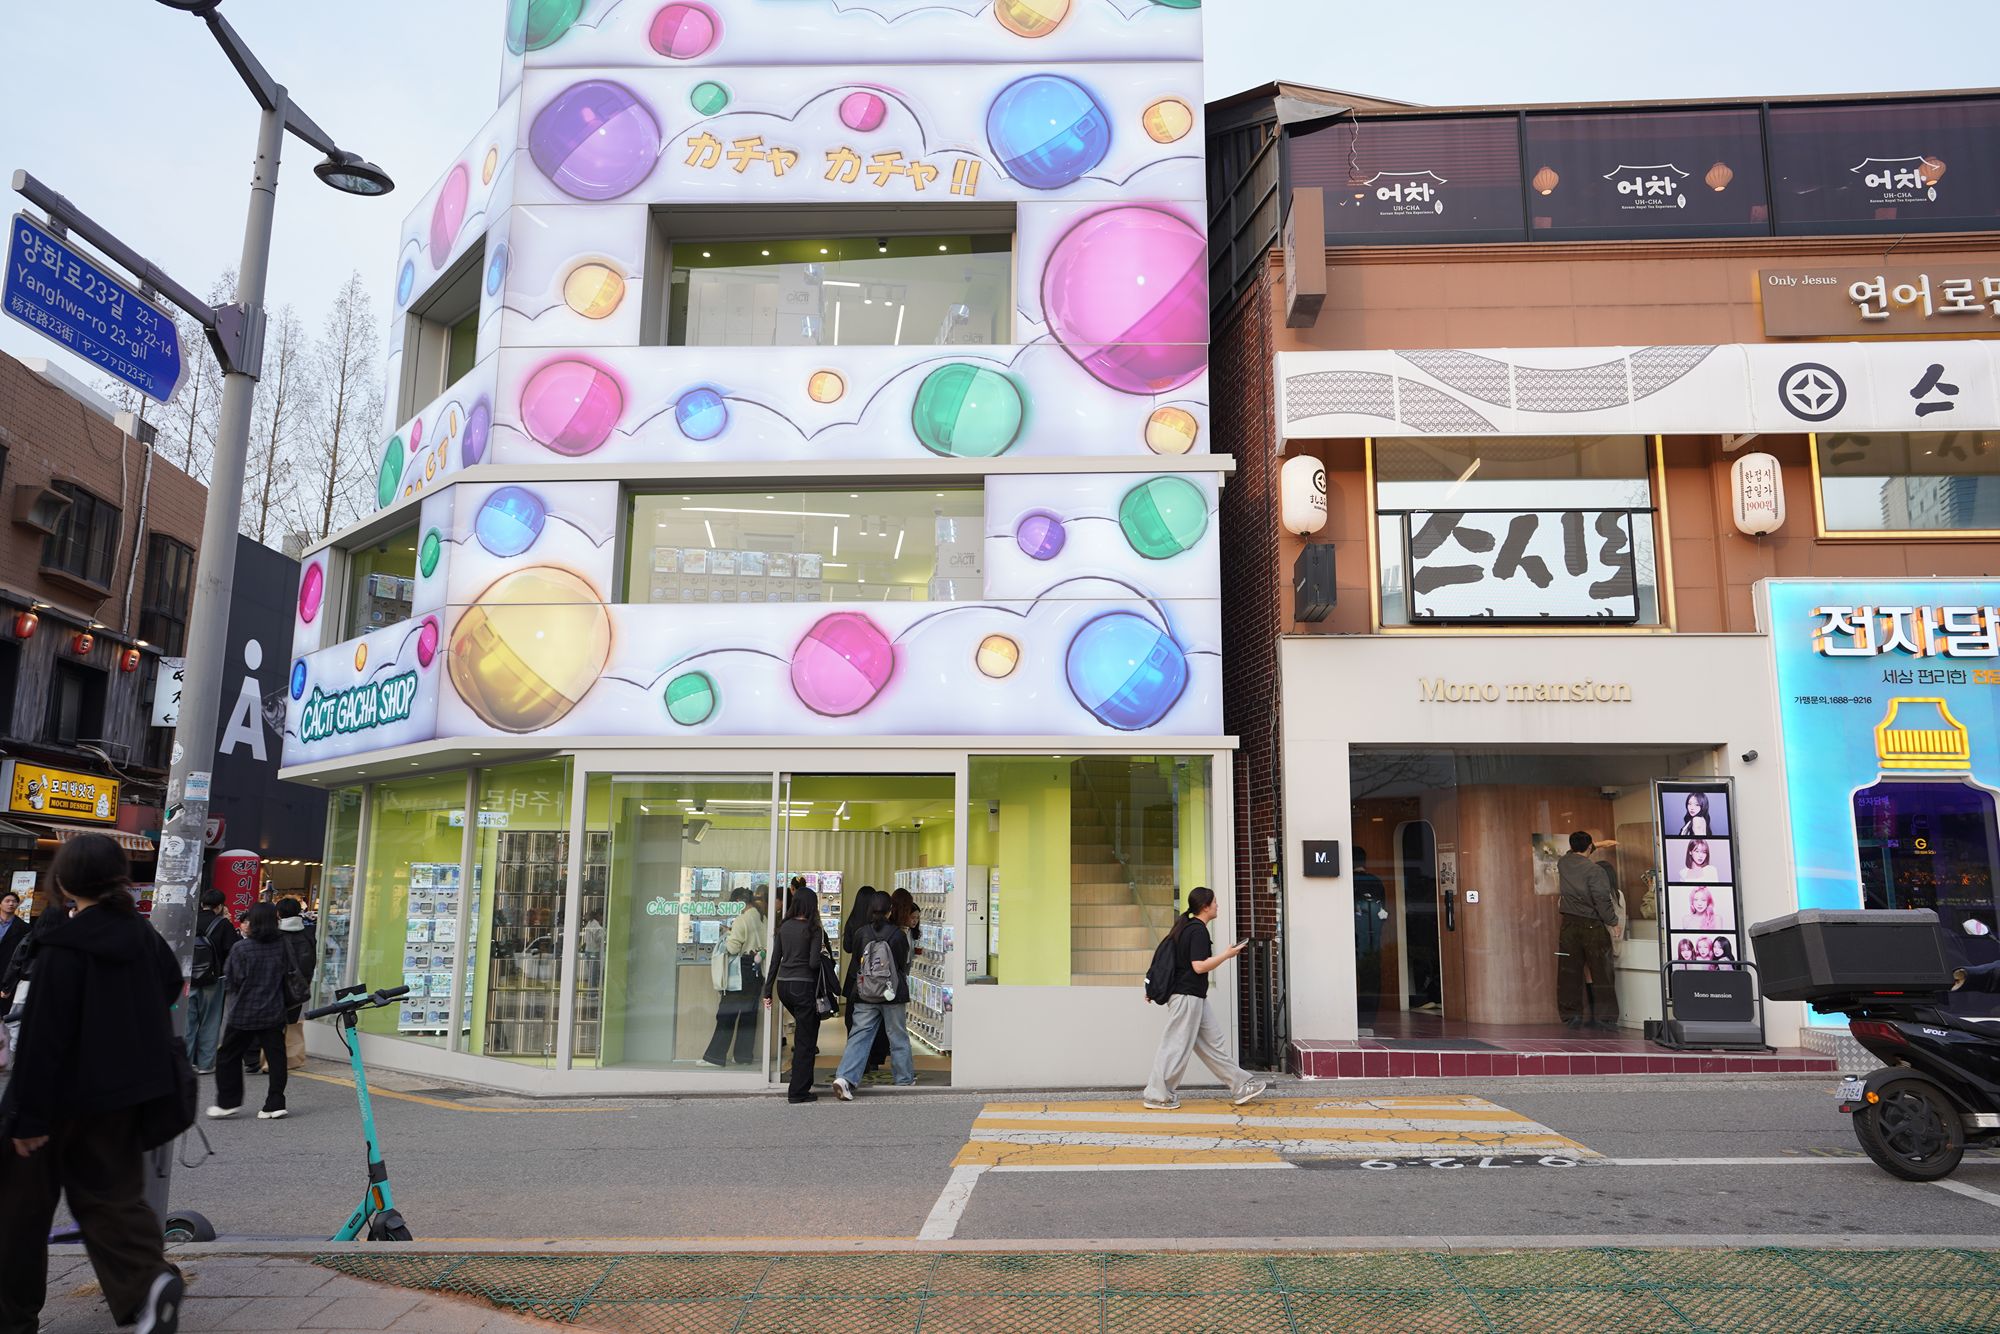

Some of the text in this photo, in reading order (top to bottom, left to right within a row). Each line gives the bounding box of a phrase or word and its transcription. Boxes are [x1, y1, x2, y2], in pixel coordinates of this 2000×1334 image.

[685, 132, 798, 177] カチャ
[1617, 175, 1677, 196] 어차
[1865, 168, 1927, 189] 어차
[1377, 182, 1435, 202] 어차
[20, 229, 127, 320] 양화로23길
[1768, 274, 1837, 286] Only Jesus
[17, 263, 148, 360] Yanghwa-ro 23-gil
[136, 306, 158, 331] 22-1
[143, 329, 172, 358] 22-14
[1882, 669, 1914, 684] 세상
[1918, 669, 1967, 684] 편리한
[1418, 676, 1632, 702] Mono mansion
[337, 683, 376, 731] GACHA
[379, 676, 416, 719] SHOP
[50, 799, 92, 811] MOCHI DESSERT
[680, 901, 716, 915] GACHA
[717, 901, 746, 915] SHOP
